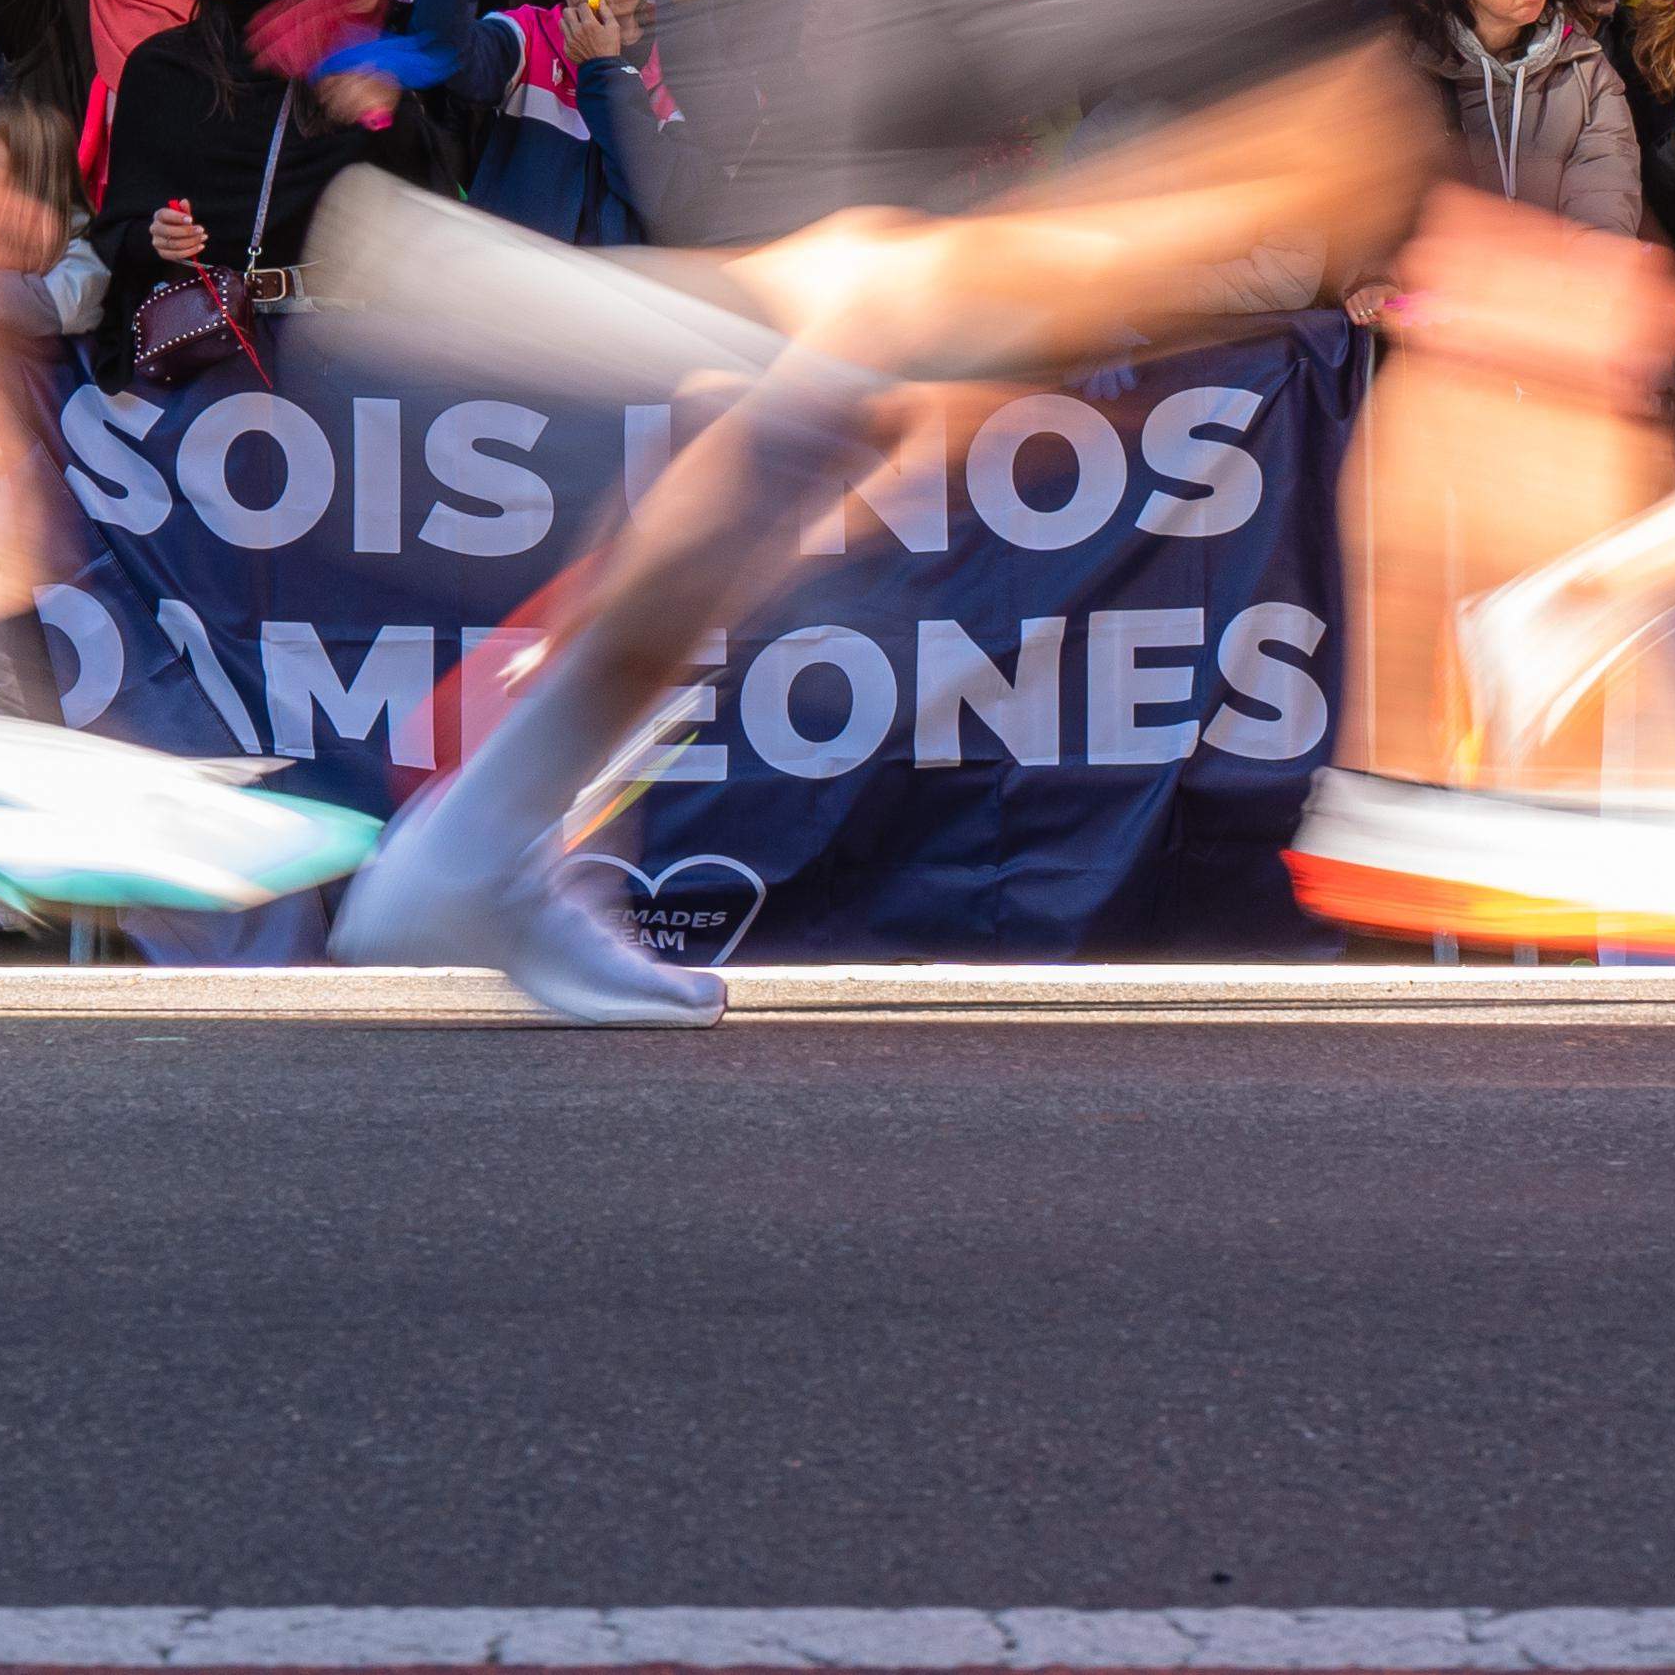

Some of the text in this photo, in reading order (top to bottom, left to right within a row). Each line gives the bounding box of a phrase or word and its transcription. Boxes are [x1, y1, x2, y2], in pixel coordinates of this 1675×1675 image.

[59, 383, 555, 557] SOIS
[608, 909, 728, 929] EMADES
[624, 927, 686, 952] EAM
